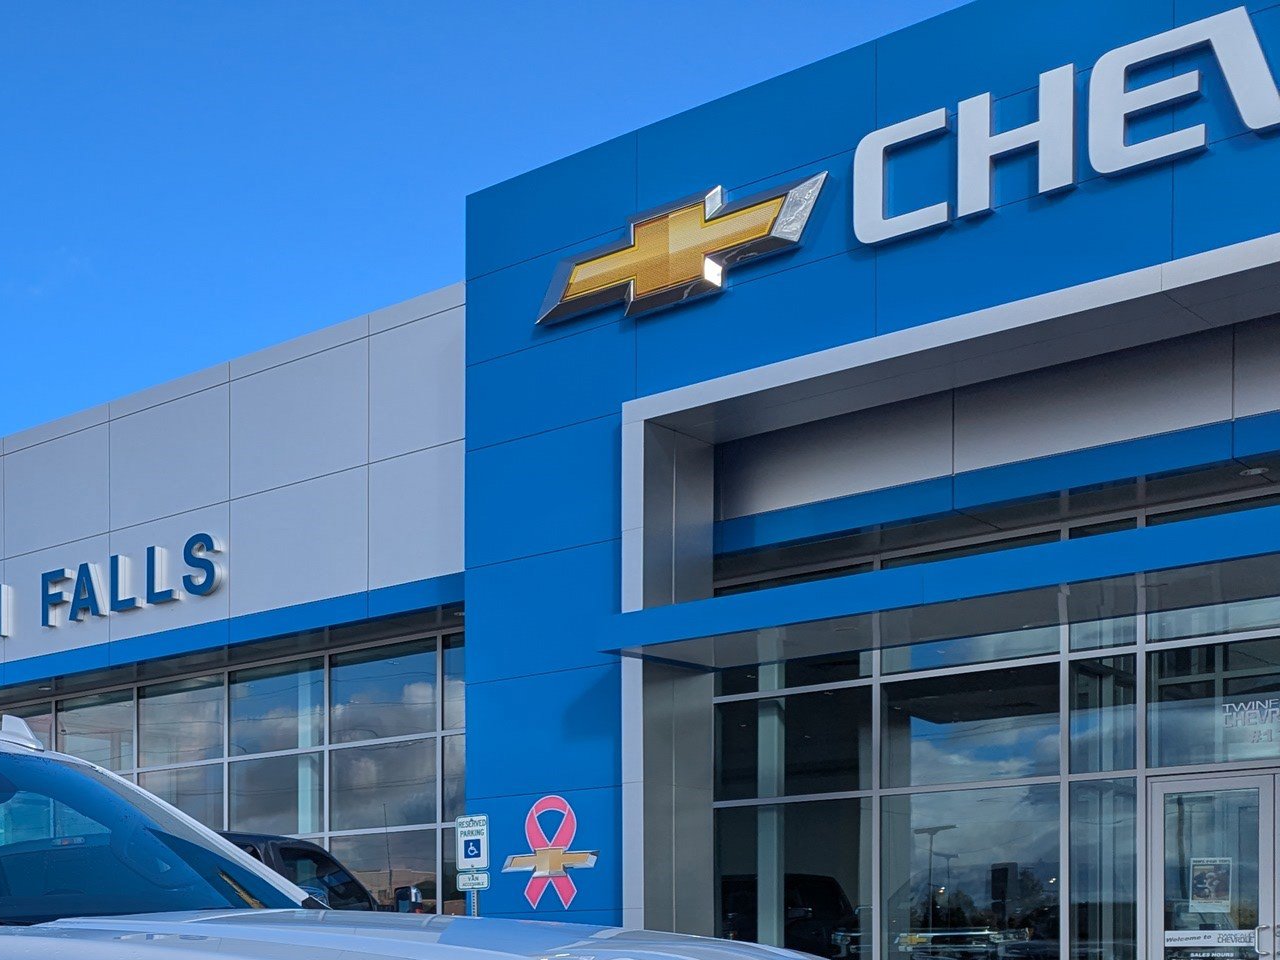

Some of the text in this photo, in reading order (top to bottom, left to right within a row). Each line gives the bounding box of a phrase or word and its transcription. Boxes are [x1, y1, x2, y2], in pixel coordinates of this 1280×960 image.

[40, 532, 224, 627] FALLS
[458, 819, 487, 829] RESERVED
[460, 829, 485, 838] PARKING
[1166, 935, 1201, 943] Welcome
